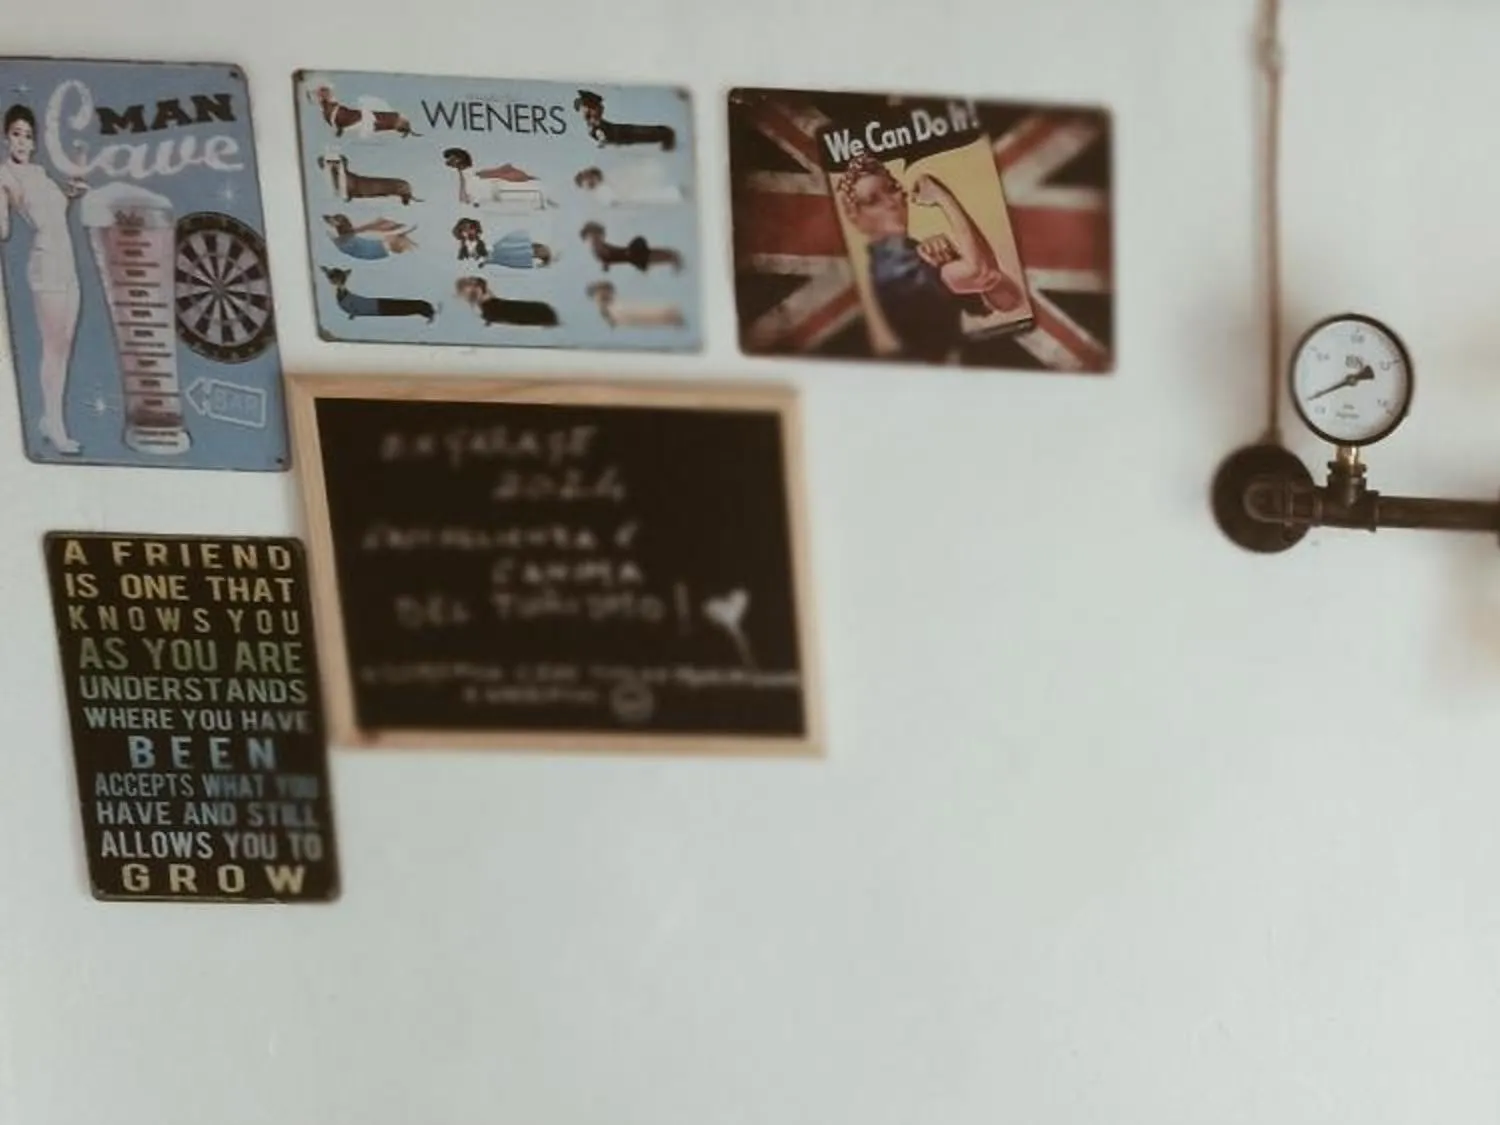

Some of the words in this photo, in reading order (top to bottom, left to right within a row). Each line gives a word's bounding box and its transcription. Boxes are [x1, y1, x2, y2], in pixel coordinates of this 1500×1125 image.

[44, 79, 245, 179] Cave
[95, 93, 237, 135] MAN
[421, 99, 567, 135] WIENERS
[823, 129, 865, 163] We
[865, 121, 912, 152] Can
[911, 109, 949, 142] Do
[64, 540, 87, 565] A
[112, 541, 291, 571] FRIEND
[64, 573, 98, 598] IS
[121, 574, 189, 600] ONE
[205, 576, 295, 603] THAT
[68, 605, 210, 633] KNOWS
[227, 609, 300, 635] YOU
[80, 637, 129, 670] AS
[142, 639, 218, 672] YOU
[235, 641, 304, 674] ARE
[80, 675, 307, 704] UNDERSTANDS
[83, 707, 175, 730] WHERE
[181, 709, 232, 731] YOU
[241, 710, 311, 733] HAVE
[127, 735, 277, 770] BEEN
[95, 773, 194, 798] ACCEPTS
[202, 775, 264, 798] WHAT
[96, 801, 172, 825] HAVE
[183, 802, 237, 825] AND
[101, 830, 213, 860] ALLOWS
[223, 832, 277, 860] YOU
[288, 833, 323, 861] TO
[121, 863, 305, 894] GROW
